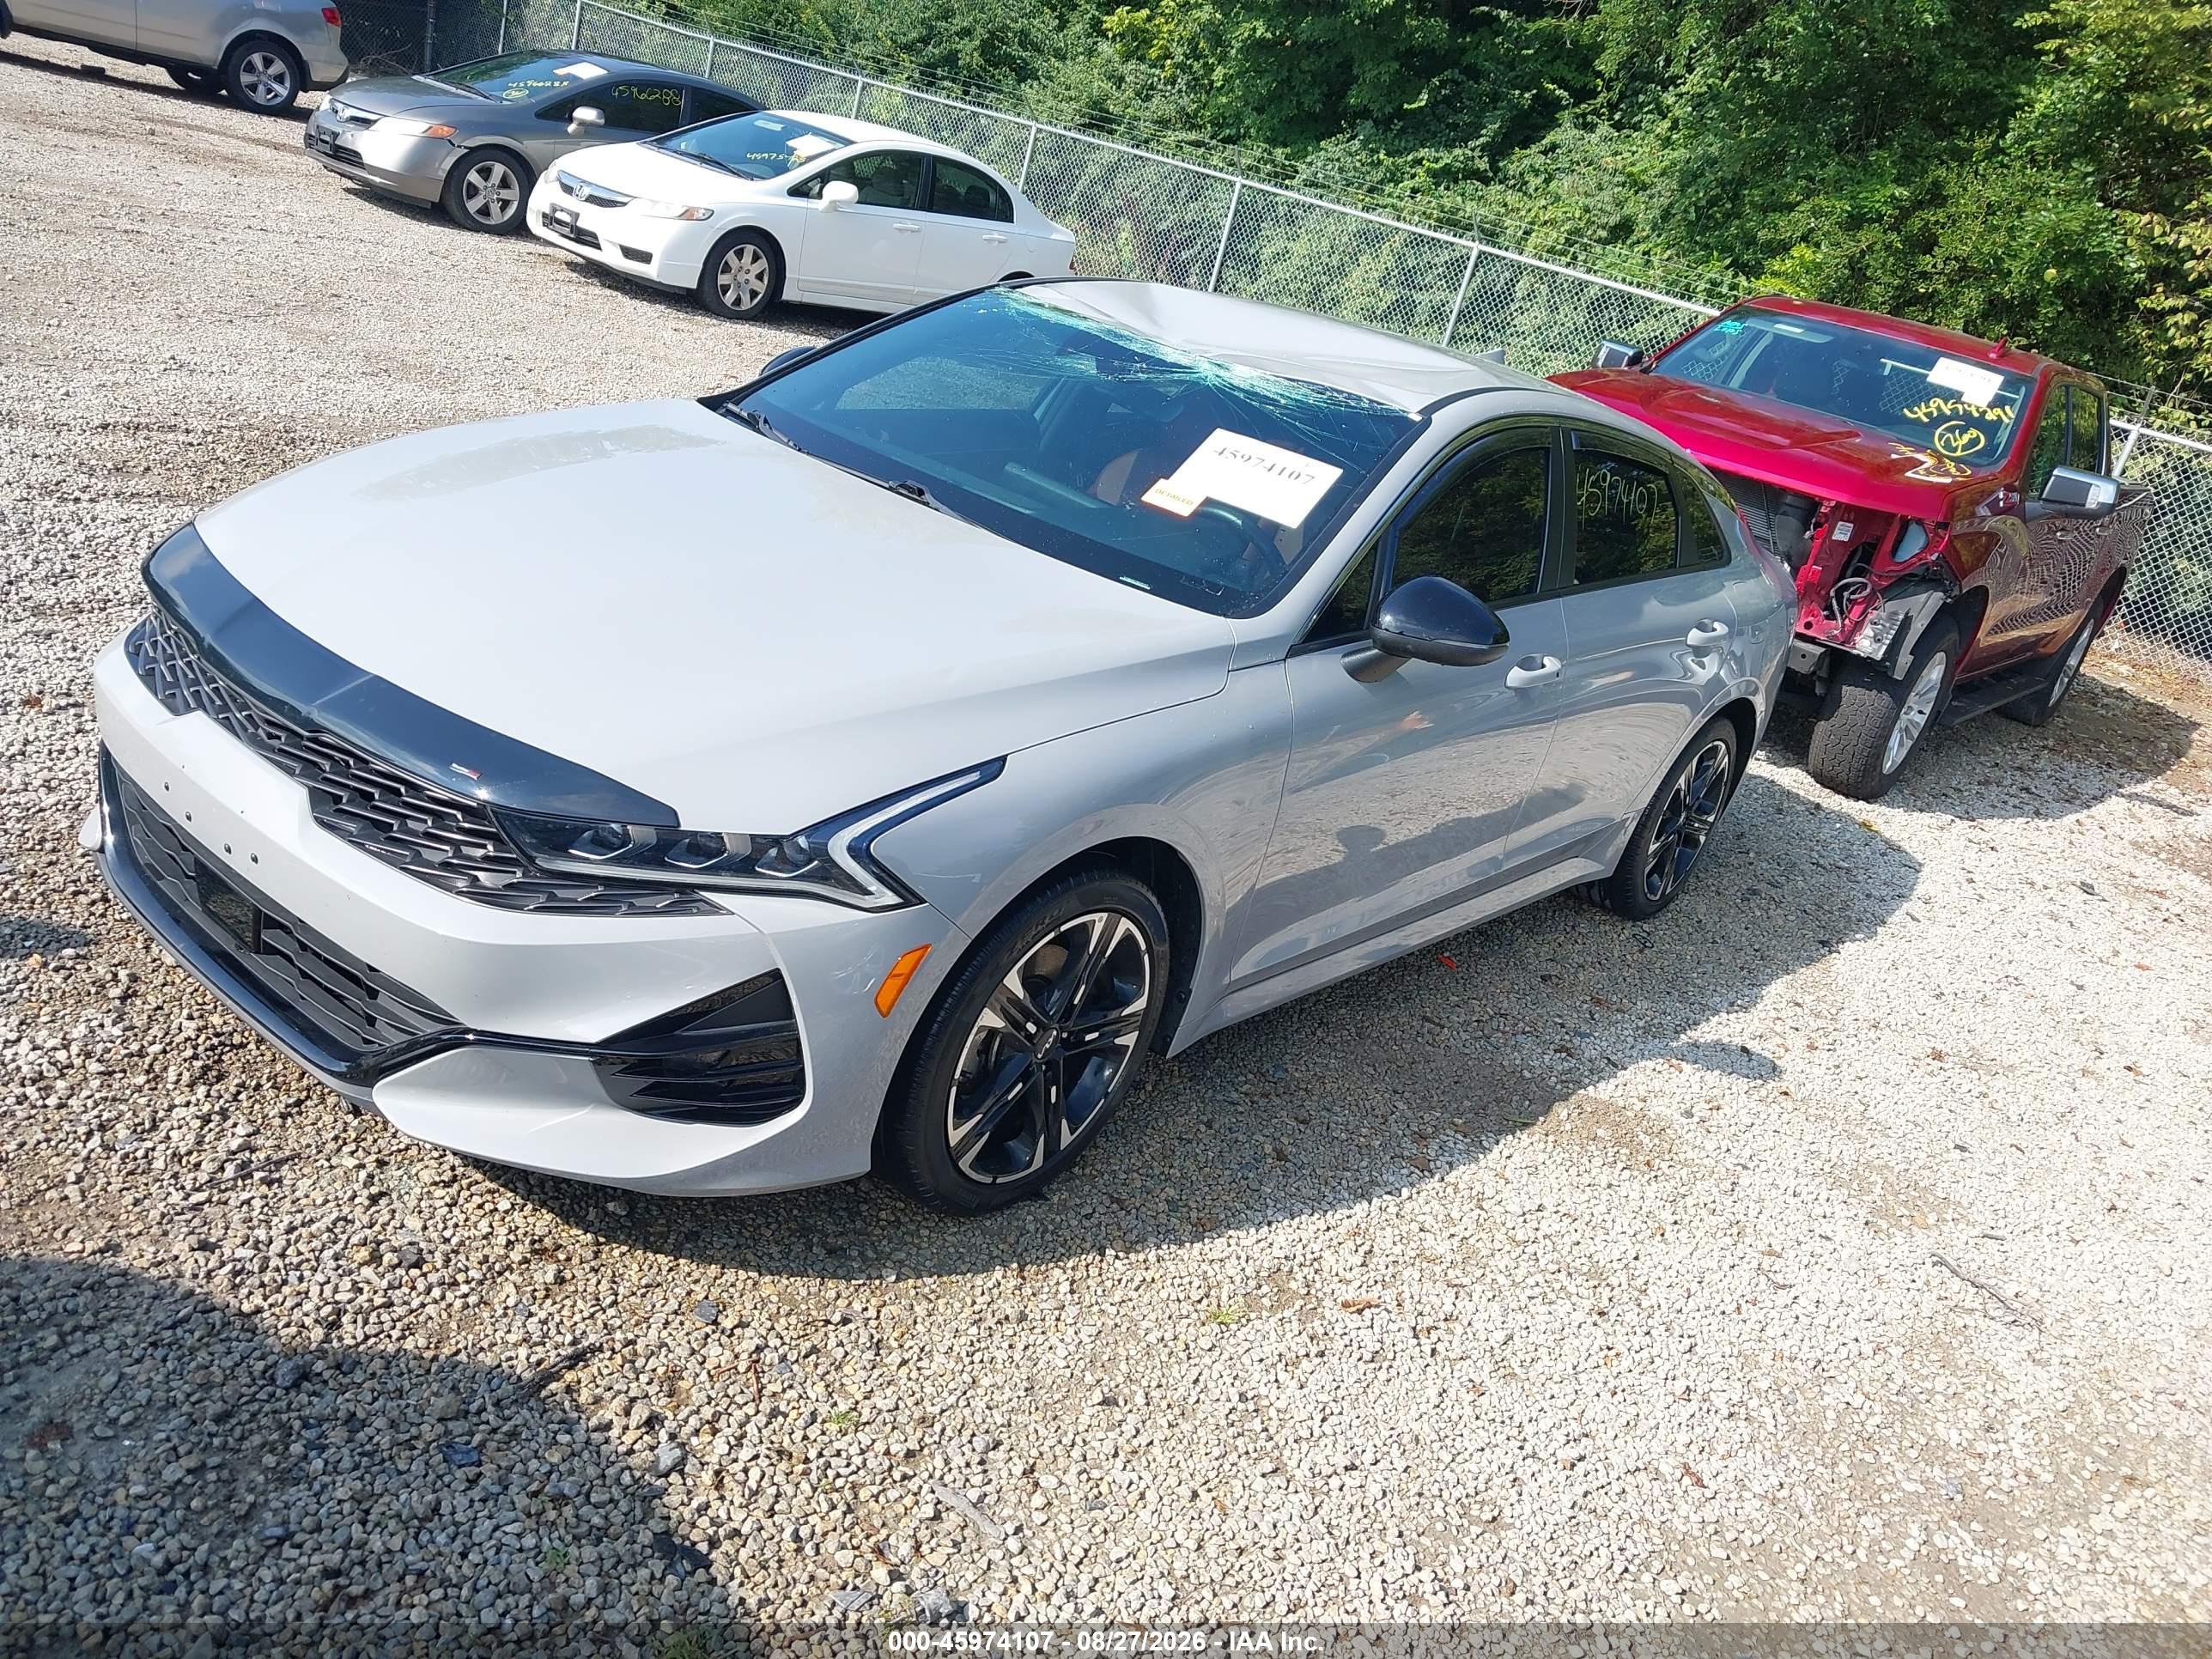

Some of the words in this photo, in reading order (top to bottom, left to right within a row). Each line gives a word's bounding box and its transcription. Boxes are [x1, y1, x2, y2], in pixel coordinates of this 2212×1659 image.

[611, 85, 682, 106] 45966288
[1212, 447, 1316, 485] 45974107
[1577, 468, 1658, 530] 45974107
